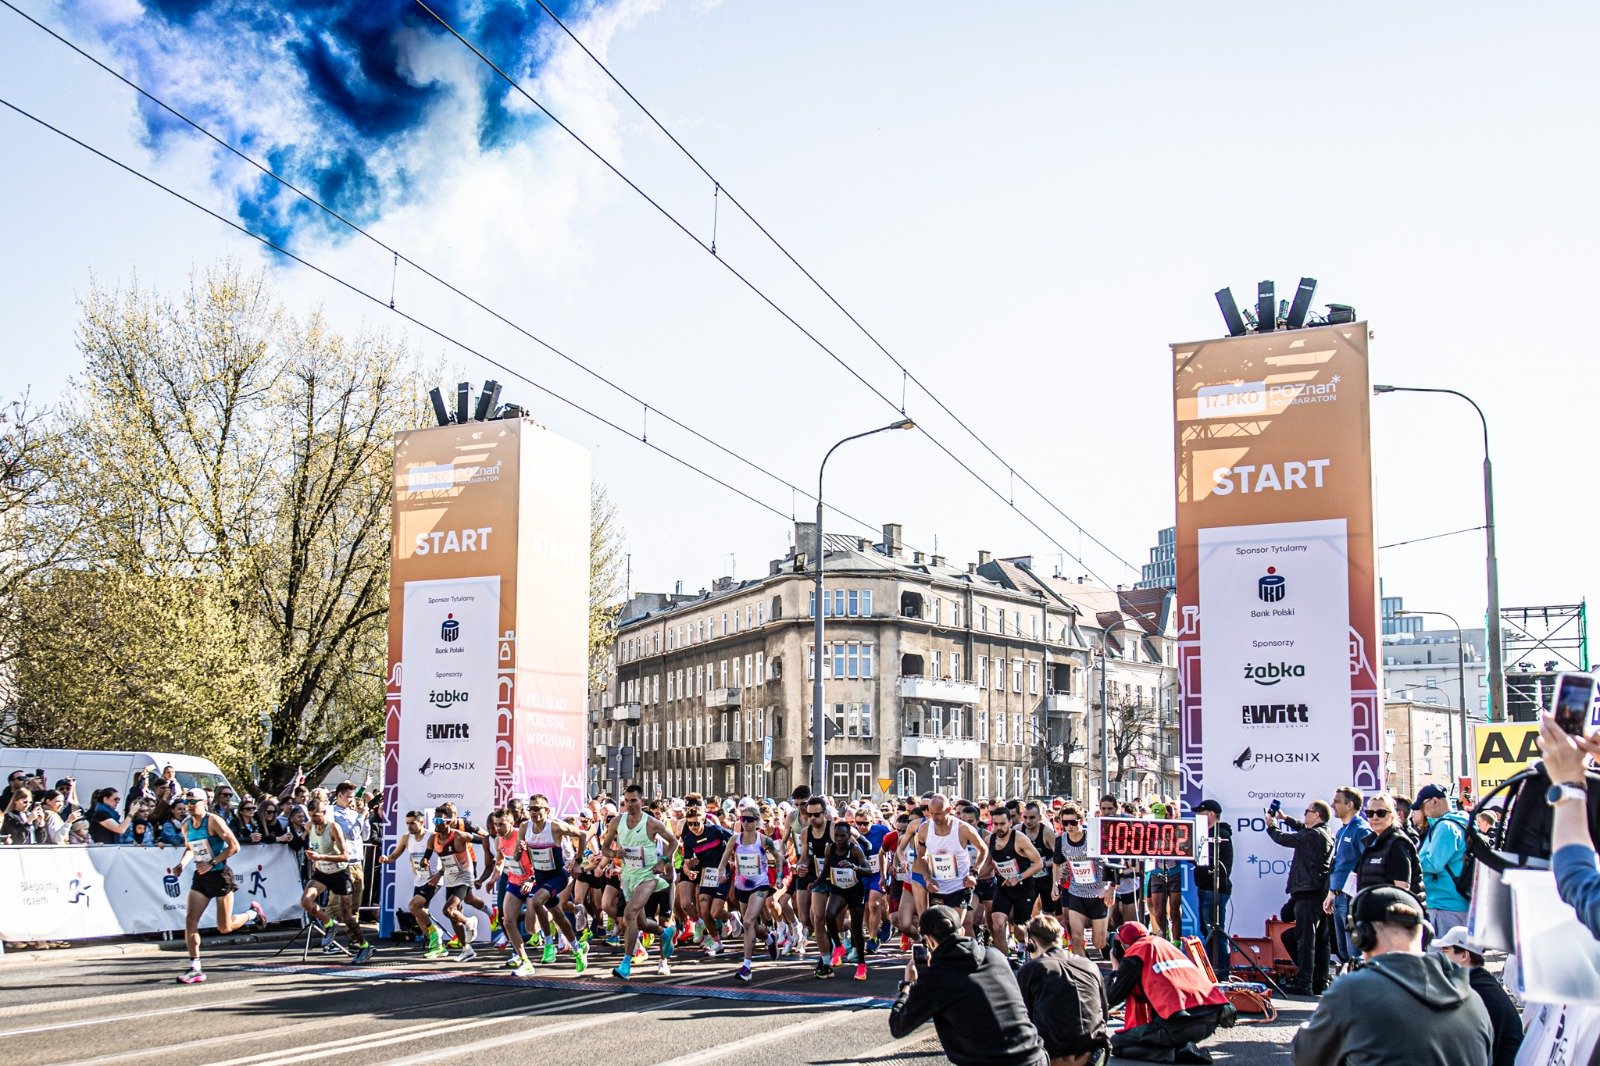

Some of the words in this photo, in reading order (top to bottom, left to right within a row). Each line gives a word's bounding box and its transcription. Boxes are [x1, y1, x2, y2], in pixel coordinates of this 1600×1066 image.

[1226, 391, 1259, 407] PKO
[1211, 459, 1330, 496] START
[415, 527, 492, 556] START
[1236, 547, 1268, 555] Sponsor
[1271, 545, 1307, 553] Tytularny
[1272, 608, 1295, 616] Polski
[1252, 639, 1294, 648] Sponsorzy
[1244, 662, 1305, 679] żabka
[429, 690, 469, 703] żabka
[1251, 704, 1308, 724] Witt
[432, 723, 469, 739] Witt
[1248, 791, 1306, 799] Organizatorzy
